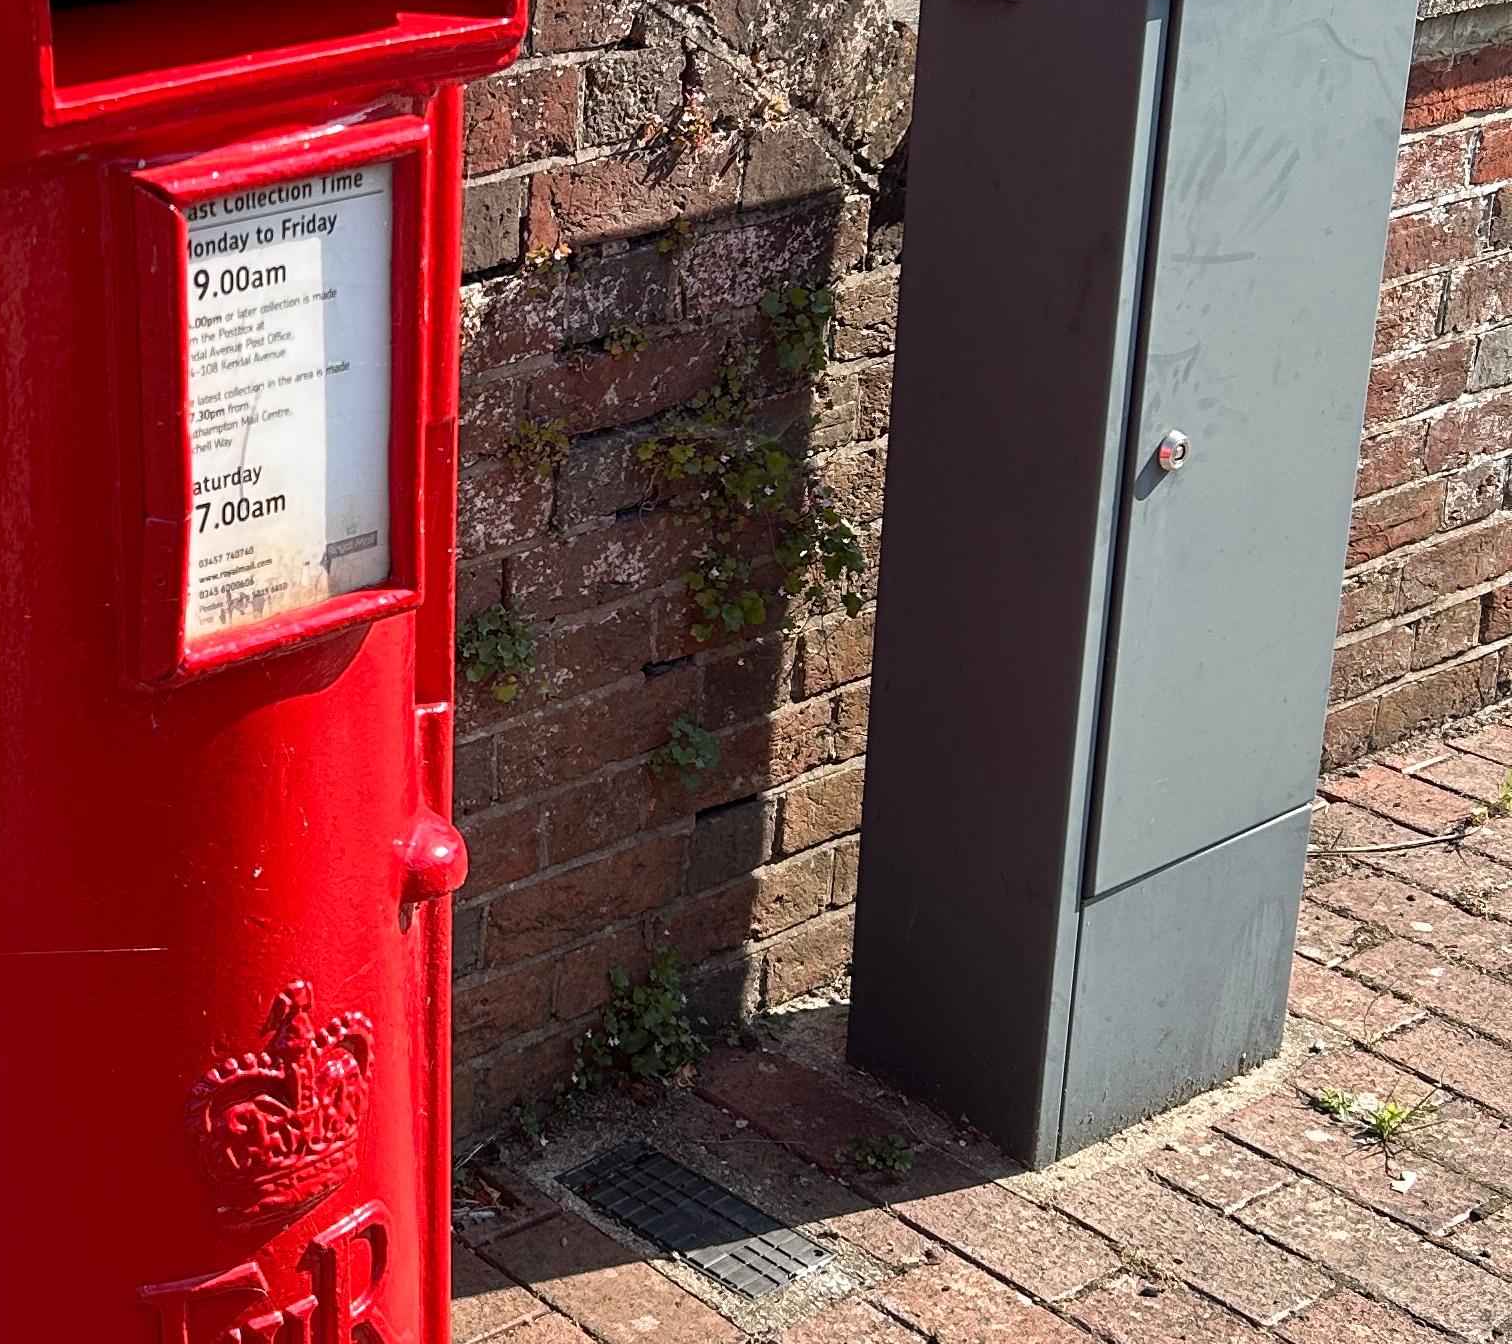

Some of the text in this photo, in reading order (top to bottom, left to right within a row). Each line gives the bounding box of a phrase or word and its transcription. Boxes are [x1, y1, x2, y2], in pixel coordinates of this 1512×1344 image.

[188, 202, 217, 223] ast
[223, 183, 312, 215] Collection
[256, 226, 274, 246] to
[282, 212, 338, 241] Friday
[193, 263, 287, 302] 9.00am
[225, 312, 234, 322] or
[237, 306, 258, 320] later
[260, 297, 300, 315] collection
[312, 287, 338, 303] made
[201, 333, 216, 344] the
[256, 320, 265, 332] at
[246, 336, 265, 350] Post
[221, 357, 251, 372] Kendal
[254, 348, 286, 364] Avenue
[197, 392, 222, 406] latest
[224, 382, 265, 400] collection
[267, 379, 276, 390] in
[278, 375, 293, 388] the
[295, 369, 314, 384] area
[325, 360, 351, 377] made
[228, 402, 250, 414] from
[241, 414, 259, 429] Mail
[214, 437, 233, 451] Way
[192, 465, 263, 497] aturday
[195, 494, 286, 534] 7.00am
